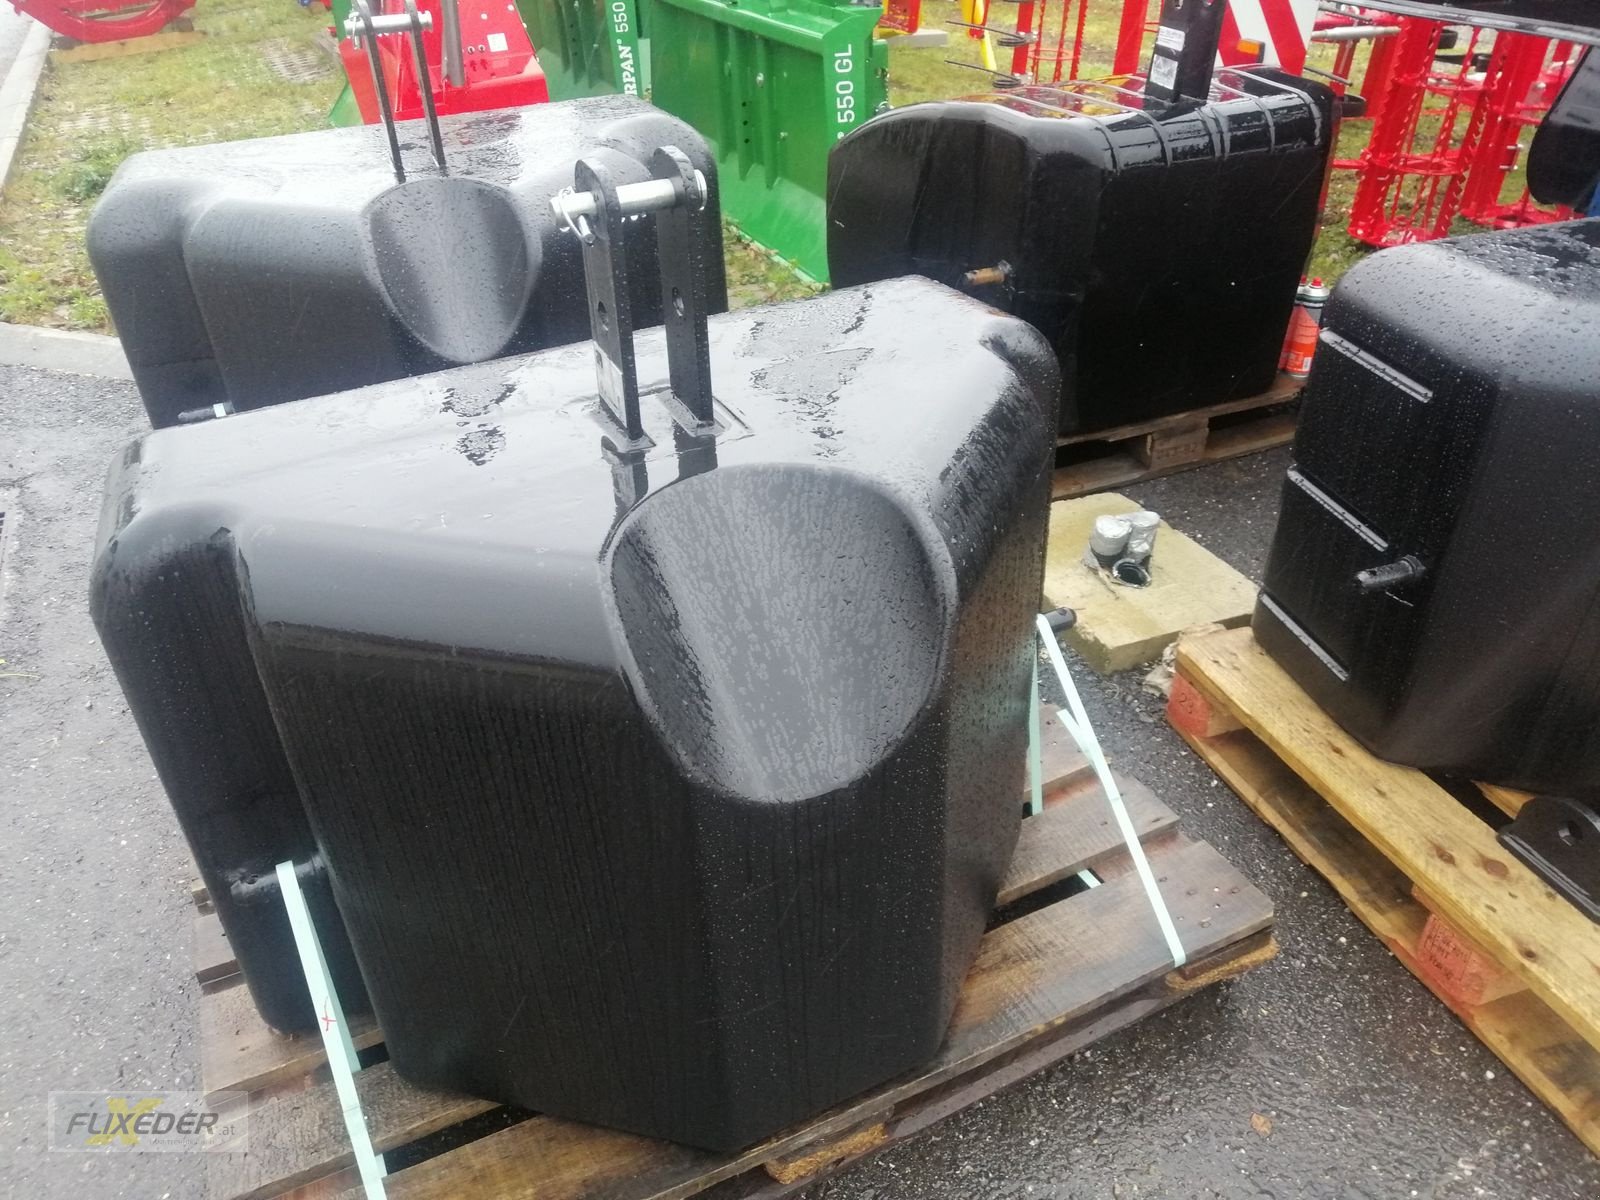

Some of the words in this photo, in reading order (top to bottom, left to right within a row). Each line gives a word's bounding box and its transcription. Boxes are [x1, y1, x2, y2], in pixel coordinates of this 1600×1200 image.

[612, 1, 629, 33] 550
[834, 43, 853, 73] GL
[836, 80, 855, 123] 550
